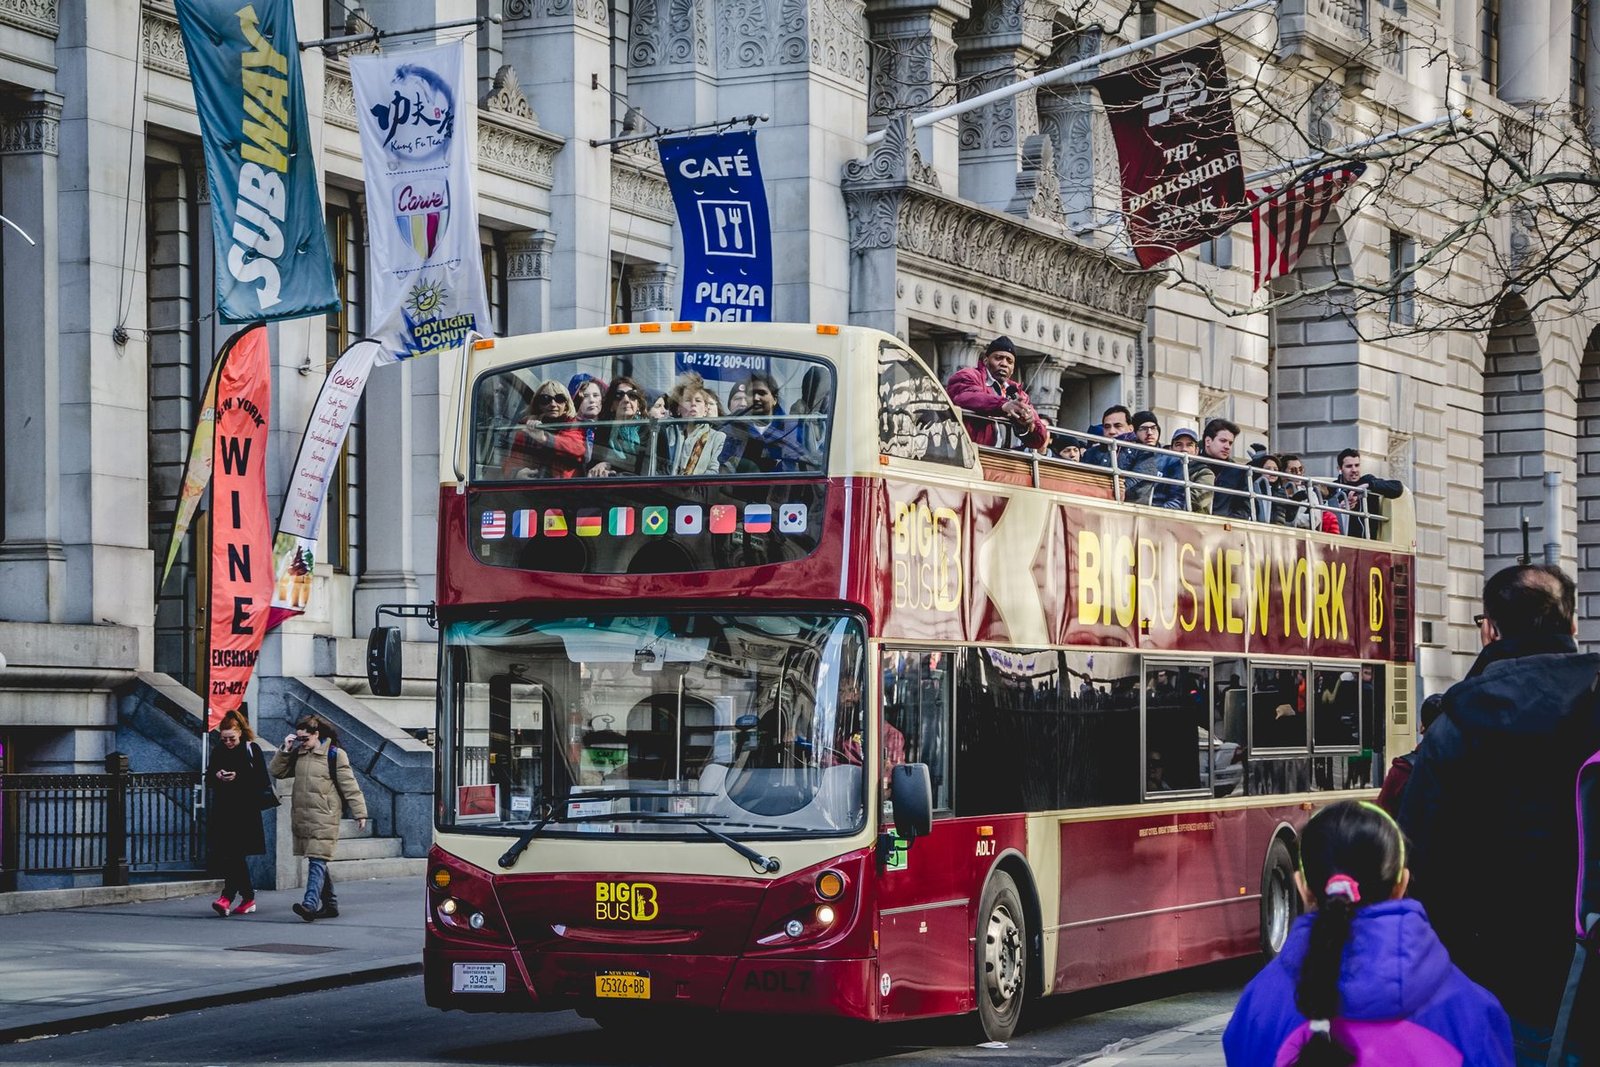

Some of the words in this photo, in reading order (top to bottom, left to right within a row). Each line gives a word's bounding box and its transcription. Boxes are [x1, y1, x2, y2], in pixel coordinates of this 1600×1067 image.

[227, 7, 289, 309] SUBWAY
[391, 139, 412, 153] Kung
[415, 137, 425, 149] Fu
[426, 136, 442, 147] Tea
[679, 149, 752, 179] CAFÉ
[1129, 152, 1240, 214] BERKSHIRE
[695, 282, 765, 306] PLAZA
[414, 314, 474, 337] DAYLIGHT
[237, 397, 266, 429] YORK
[220, 435, 254, 635] WINE
[895, 501, 932, 557] BIG
[895, 560, 933, 610] BUS
[1078, 531, 1136, 627] BIG
[1138, 538, 1198, 632] BUS
[1204, 545, 1271, 637] NEW
[1278, 556, 1348, 641] YORK
[976, 840, 990, 856] ADL
[991, 840, 996, 855] 7
[596, 882, 630, 902] BIG
[596, 902, 631, 921] BUS
[469, 975, 488, 984] 3349
